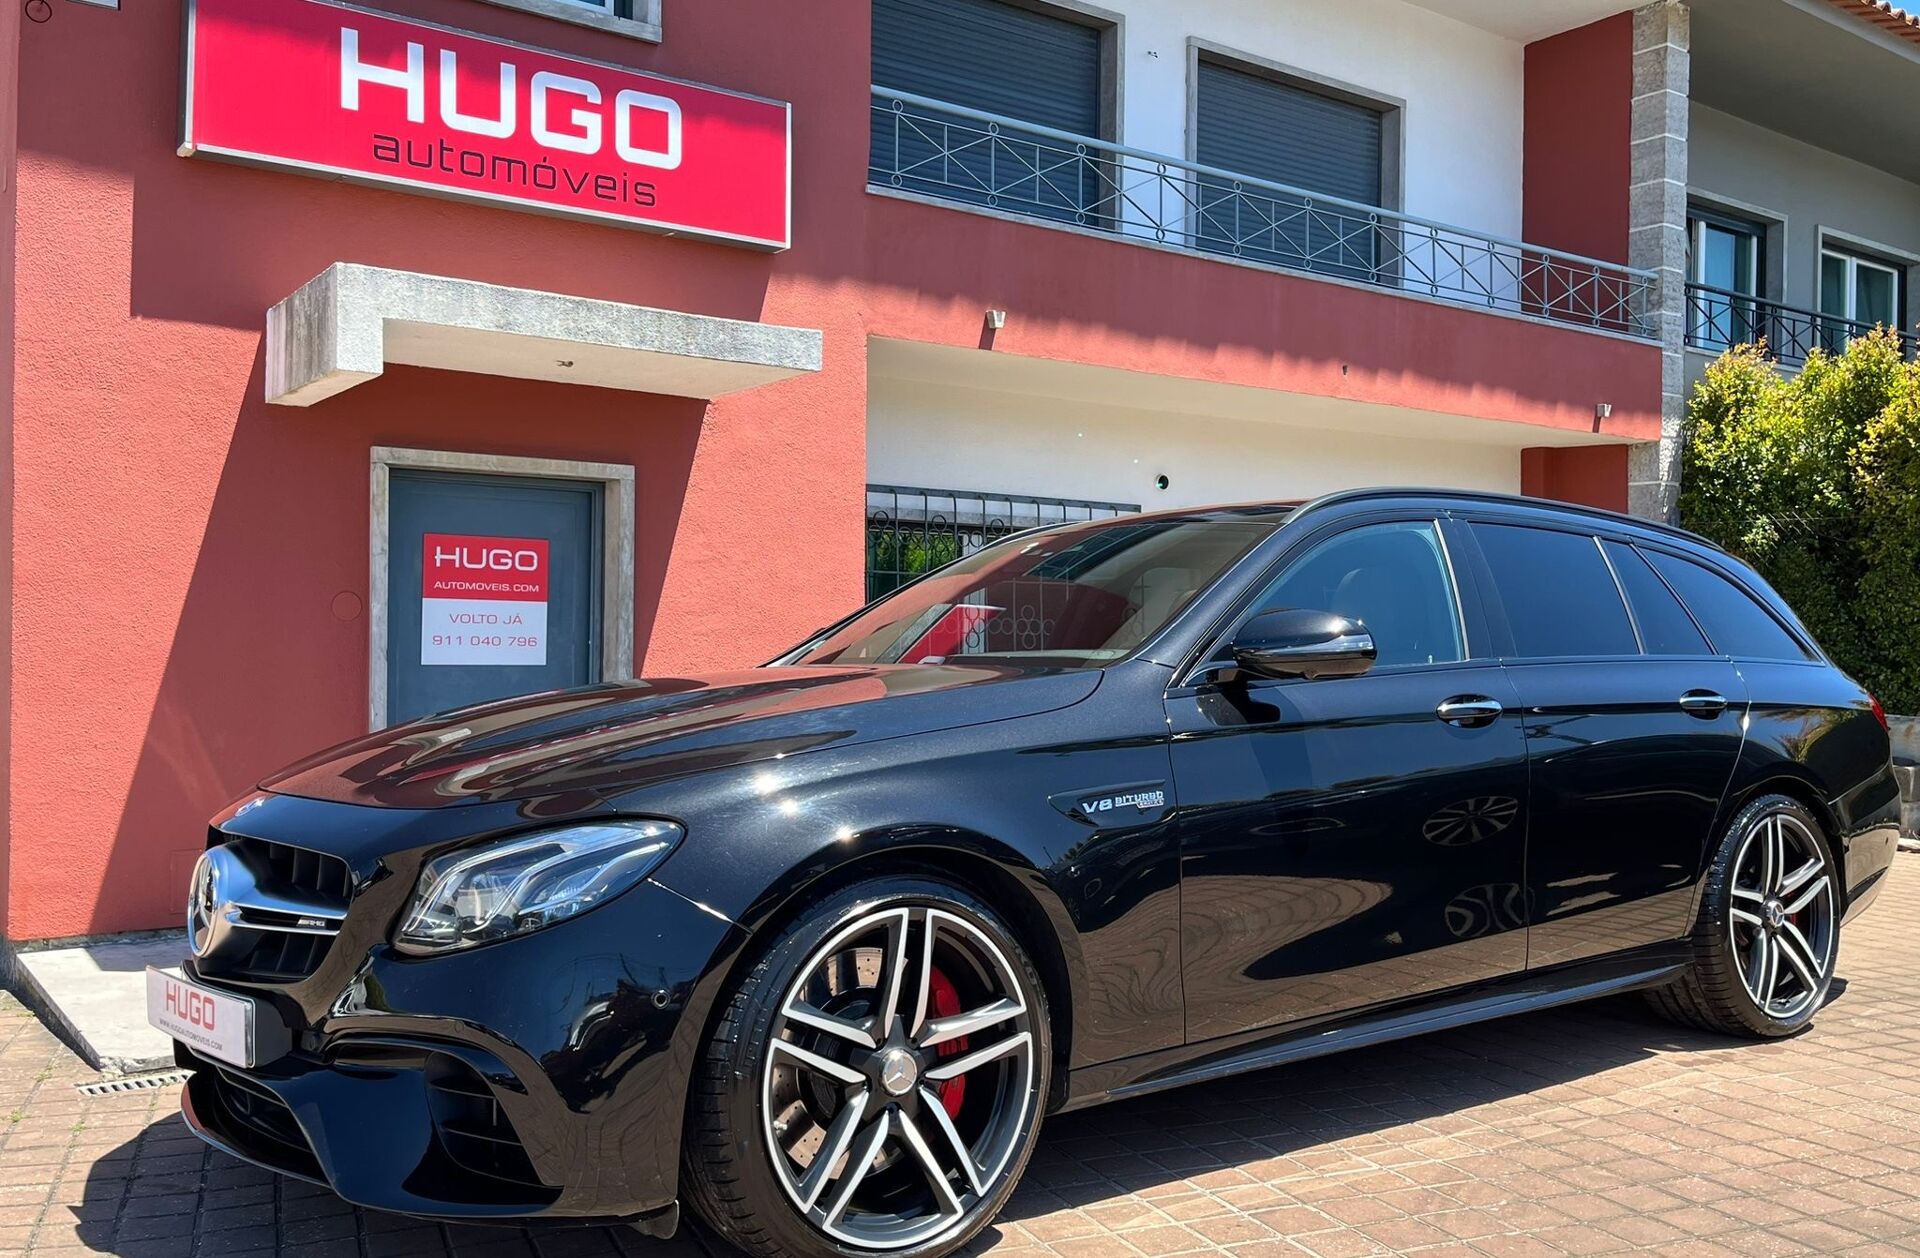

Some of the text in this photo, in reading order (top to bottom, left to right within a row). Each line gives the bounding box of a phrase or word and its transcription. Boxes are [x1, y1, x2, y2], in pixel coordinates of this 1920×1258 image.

[340, 27, 684, 170] HUGO
[372, 131, 657, 208] automóveis
[434, 545, 538, 571] HUGO
[449, 612, 523, 625] VOLTO JÁ
[432, 635, 538, 647] 911 040 796
[1082, 798, 1113, 814] V8
[1115, 790, 1164, 805] BITURBO
[165, 980, 216, 1031] HUGO
